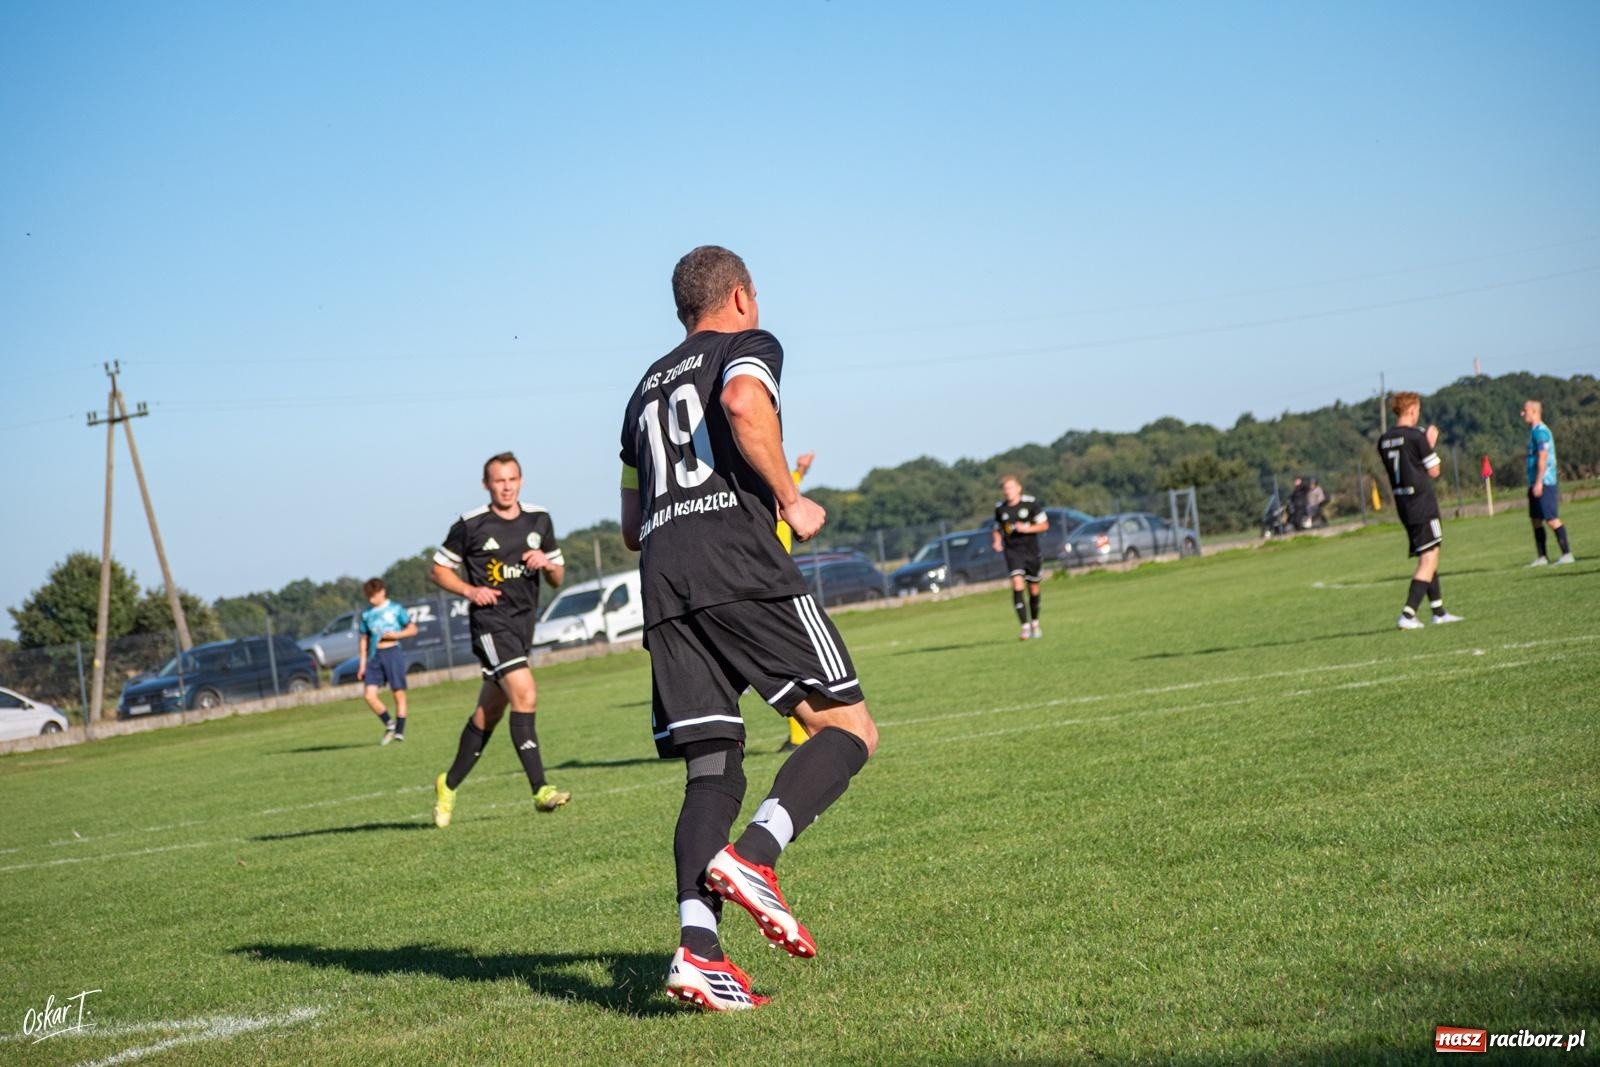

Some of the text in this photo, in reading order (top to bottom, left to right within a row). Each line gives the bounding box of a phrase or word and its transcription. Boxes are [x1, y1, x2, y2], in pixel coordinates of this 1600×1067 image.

[662, 353, 704, 385] ZGODA
[638, 383, 715, 498] 19
[1388, 450, 1400, 484] 7
[674, 491, 738, 514] KSIĄŻĘCA
